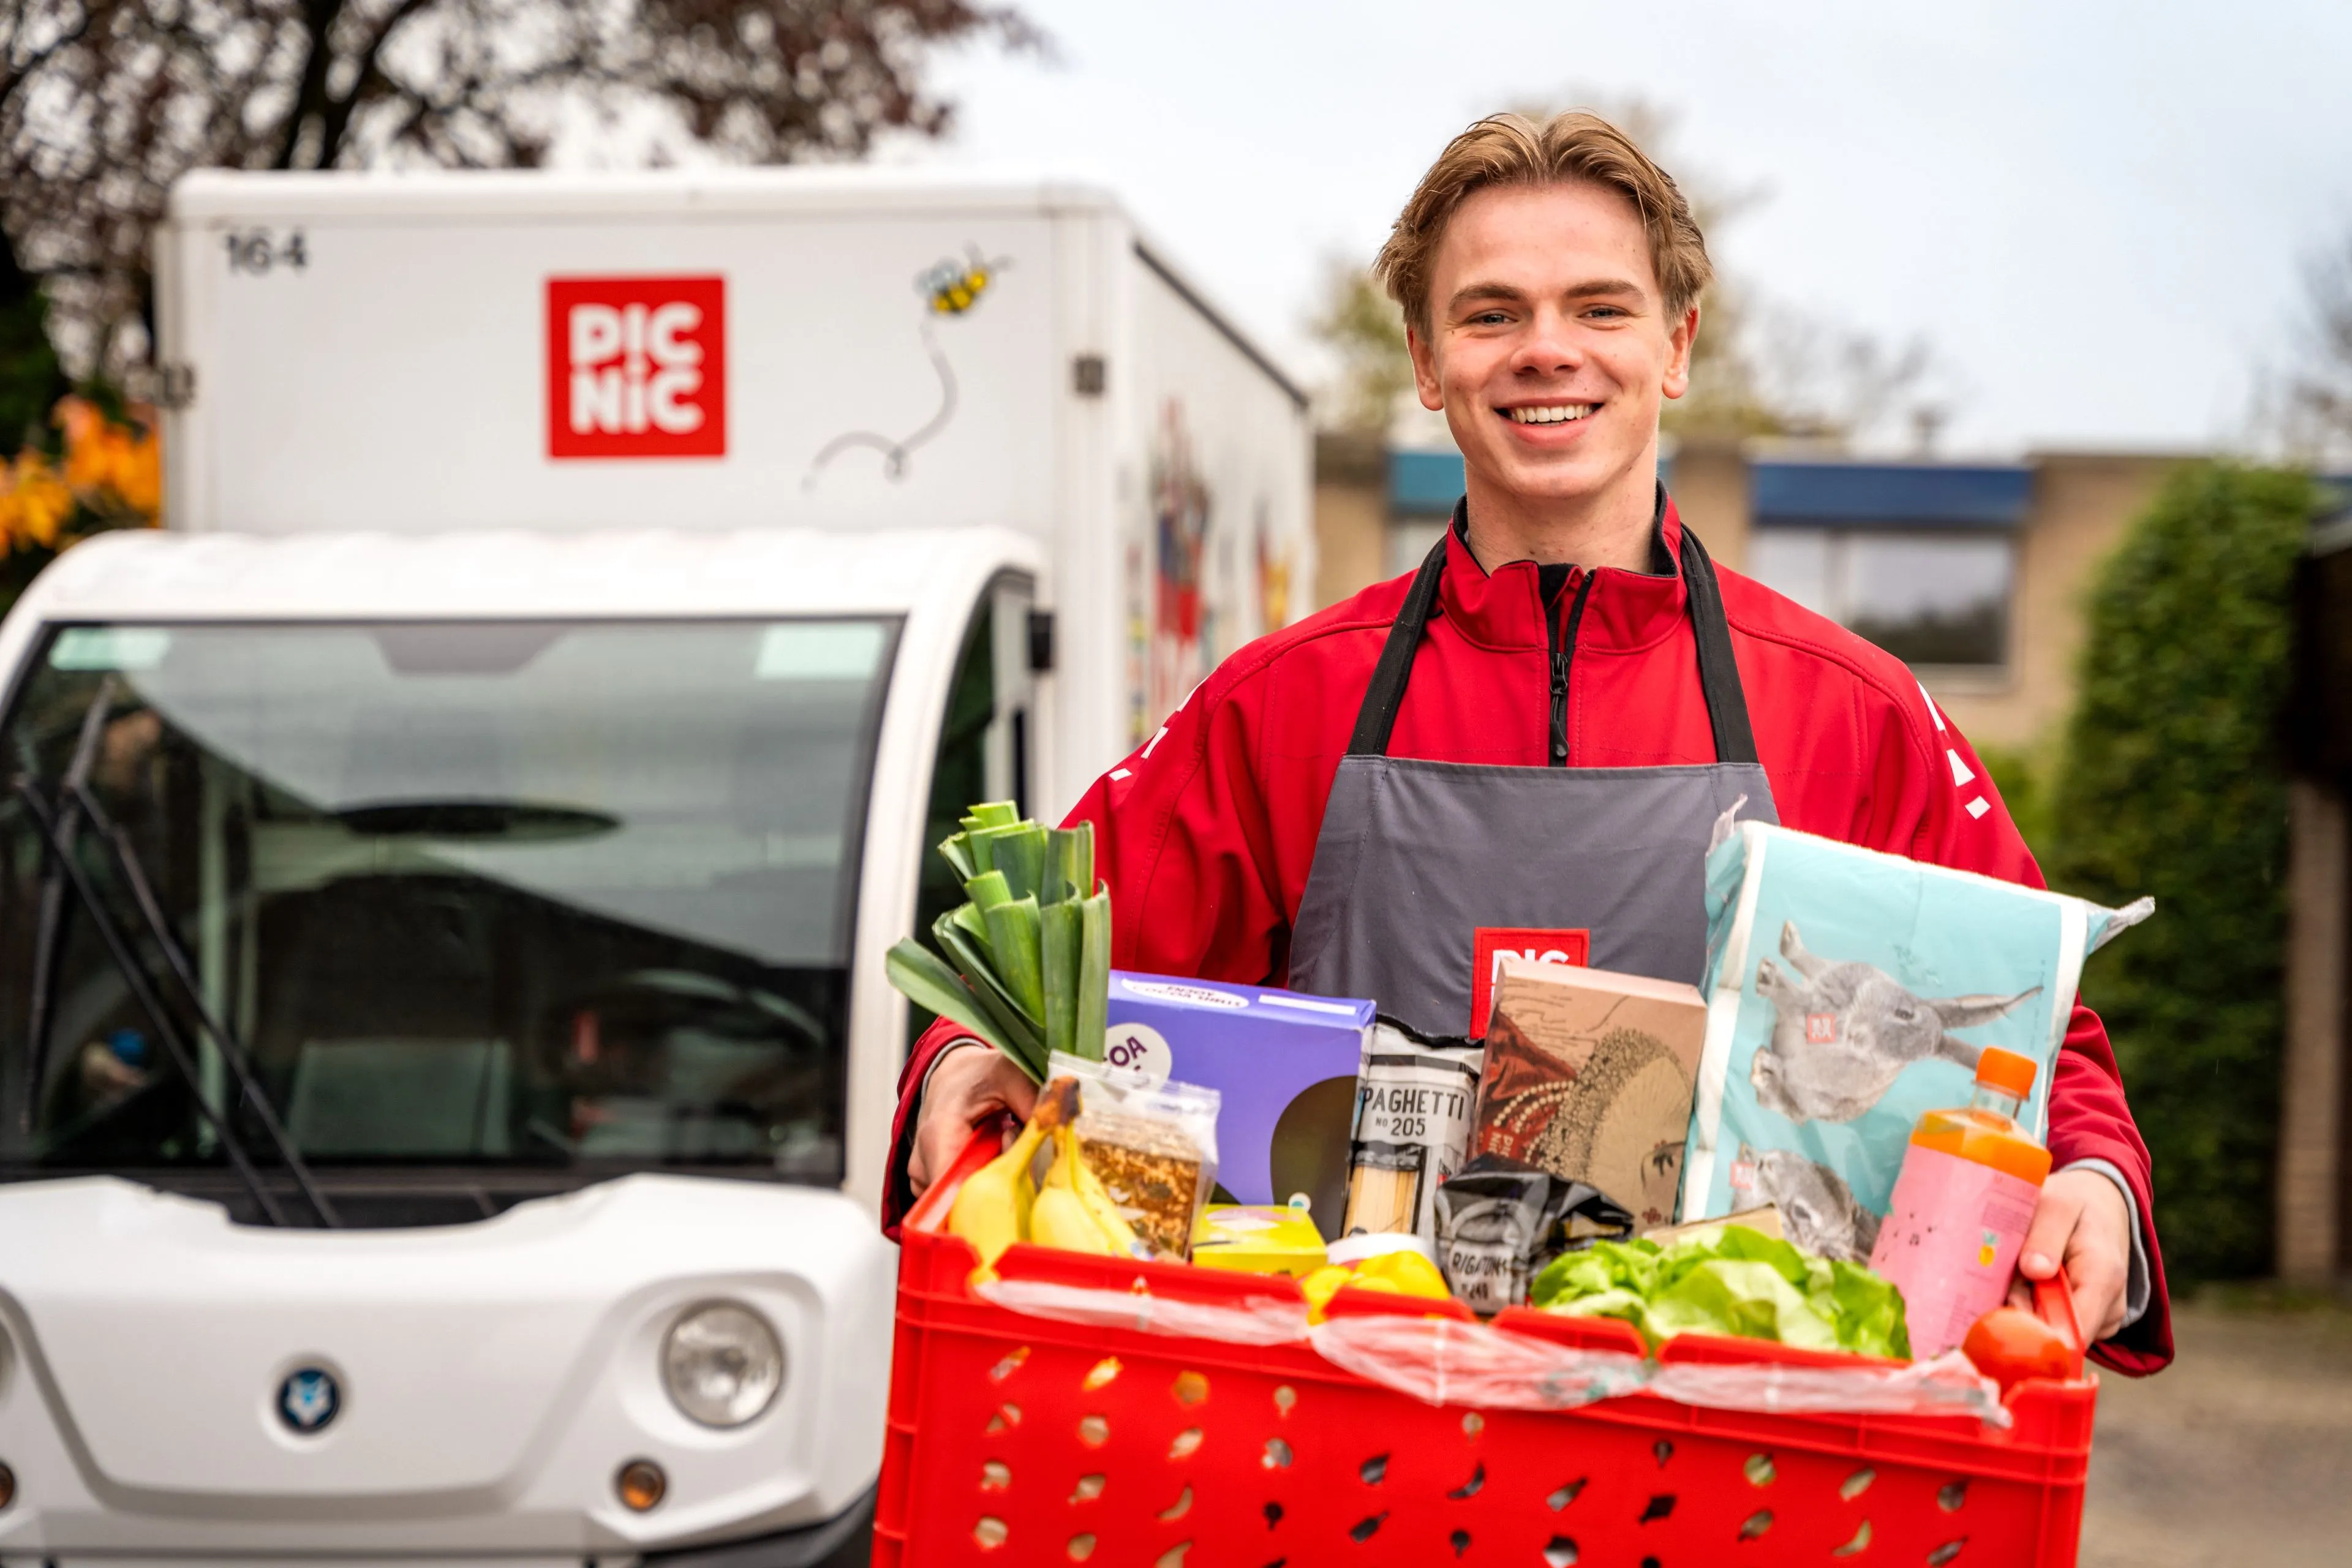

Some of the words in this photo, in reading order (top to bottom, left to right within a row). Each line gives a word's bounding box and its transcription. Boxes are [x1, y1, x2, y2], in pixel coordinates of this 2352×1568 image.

[567, 302, 704, 368] PIC
[1103, 1036, 1148, 1067] OA
[1391, 1117, 1426, 1136] 205
